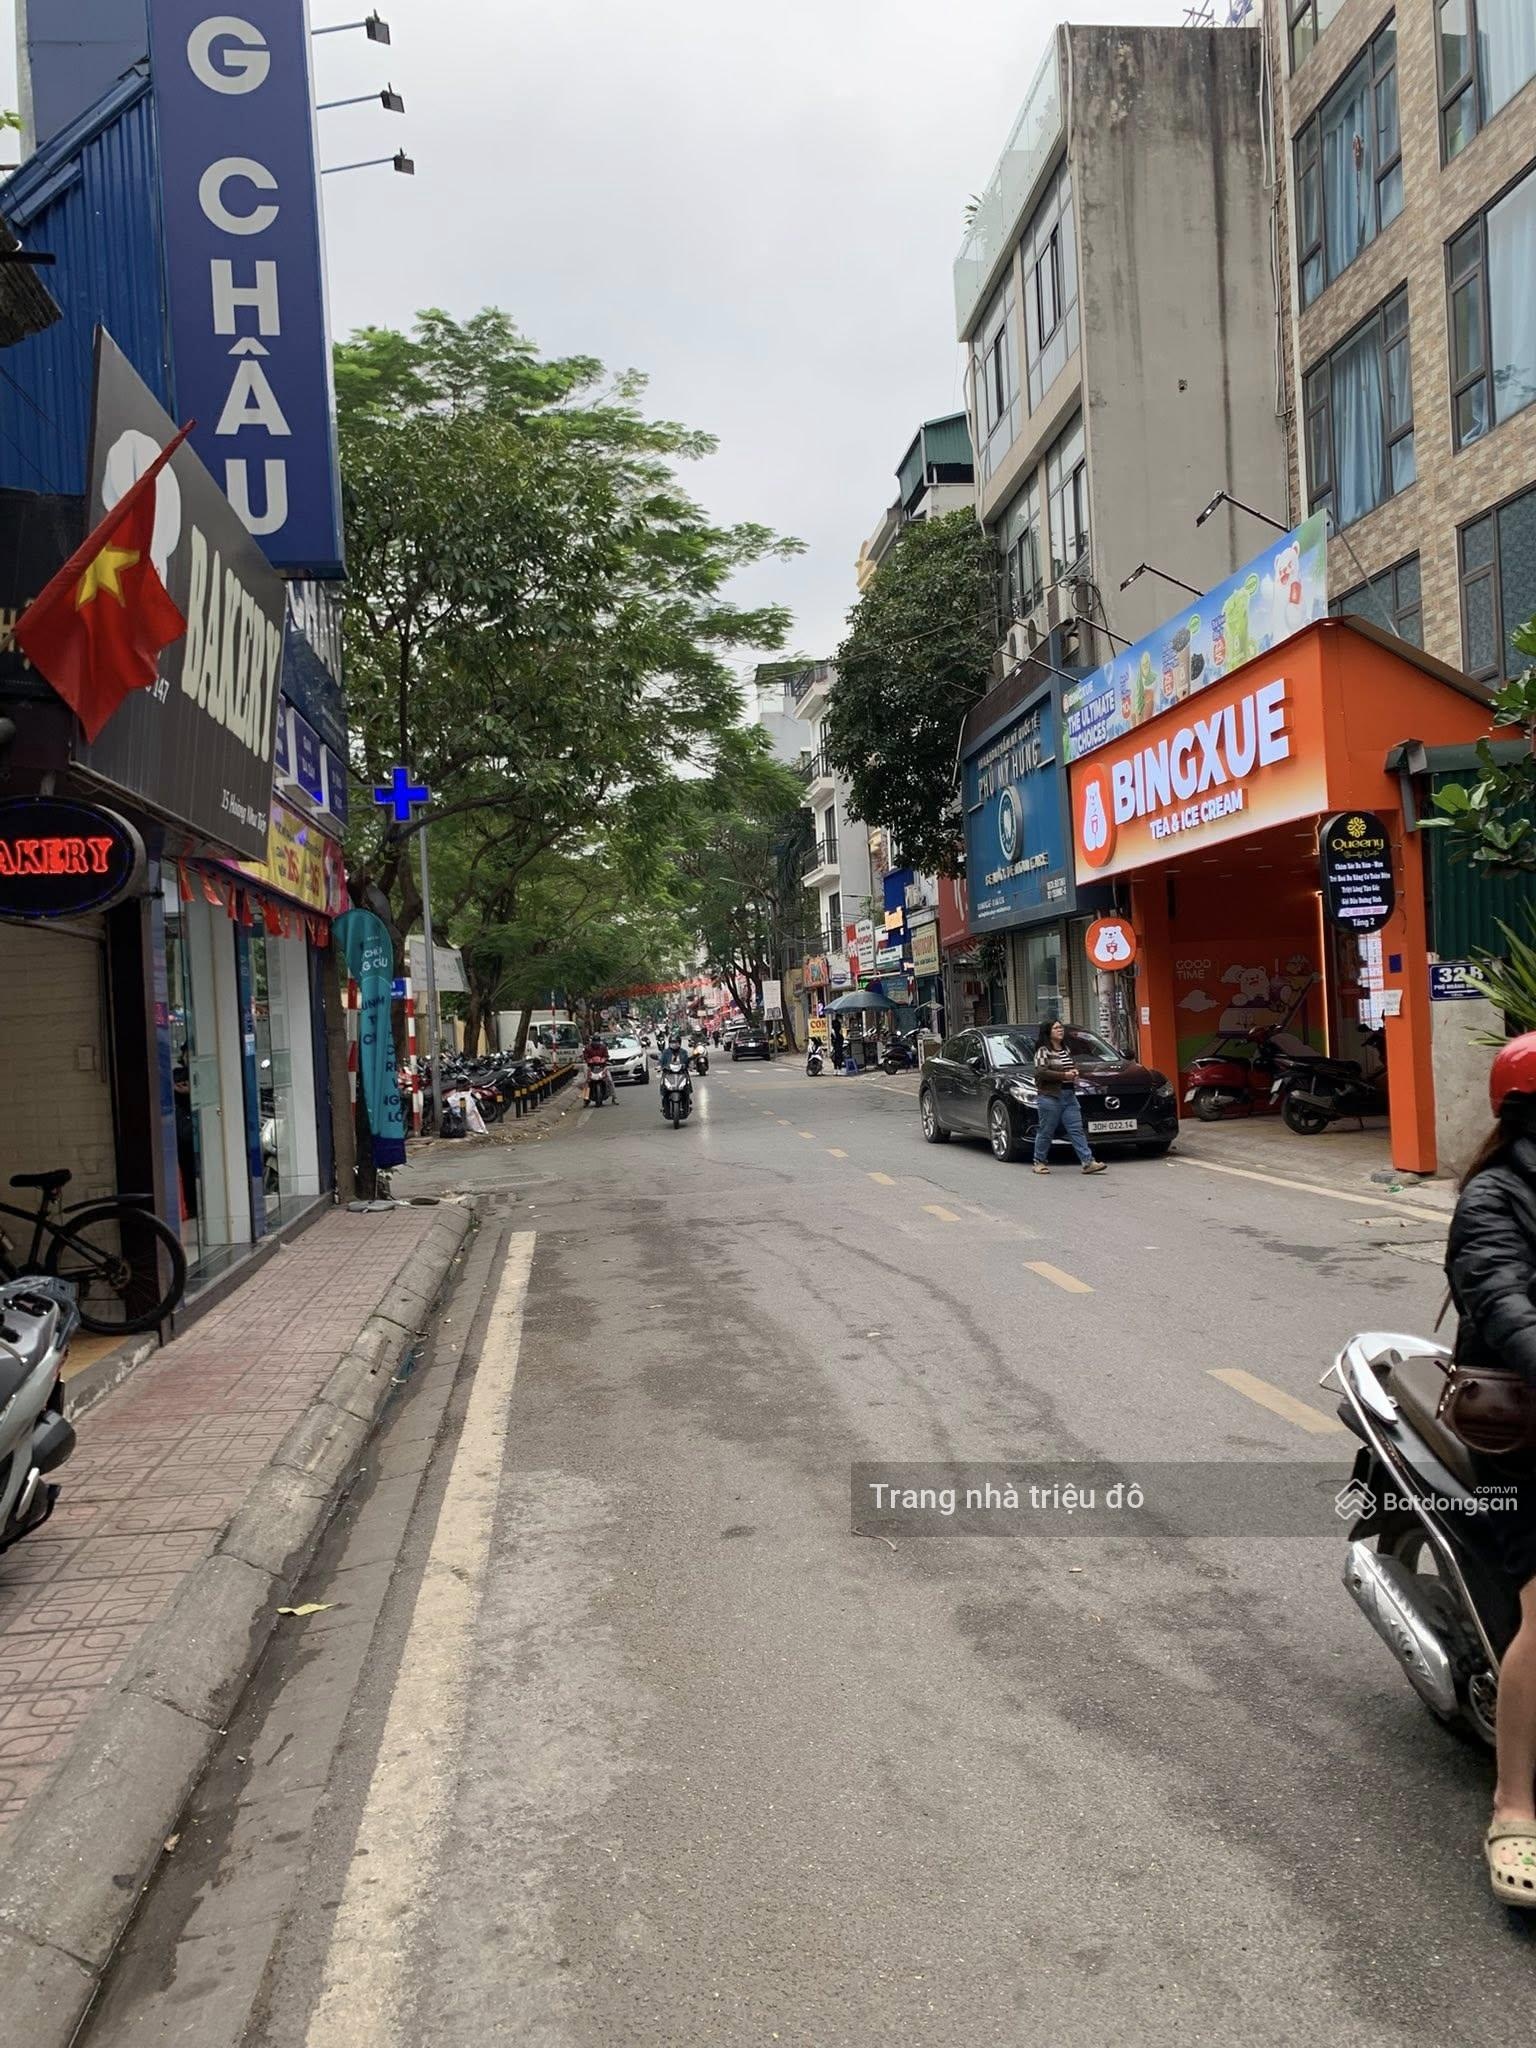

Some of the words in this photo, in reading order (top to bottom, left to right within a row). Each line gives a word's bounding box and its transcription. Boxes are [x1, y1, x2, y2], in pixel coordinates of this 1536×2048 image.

[199, 157, 292, 536] CHÂU
[181, 524, 281, 764] BAKERY
[1068, 711, 1081, 735] THE
[1081, 690, 1115, 727] ULTIMATE
[1078, 720, 1107, 752] CHOICES
[1111, 678, 1290, 826] BINGXUE
[1150, 816, 1171, 839] TEA
[1171, 816, 1180, 831] &
[1181, 805, 1200, 830] ICE
[1200, 788, 1244, 824] CREAM
[1332, 839, 1384, 851] Queeny
[1176, 959, 1211, 969] GOOD
[1176, 969, 1205, 981] TIME
[1092, 1122, 1107, 1131] 30H
